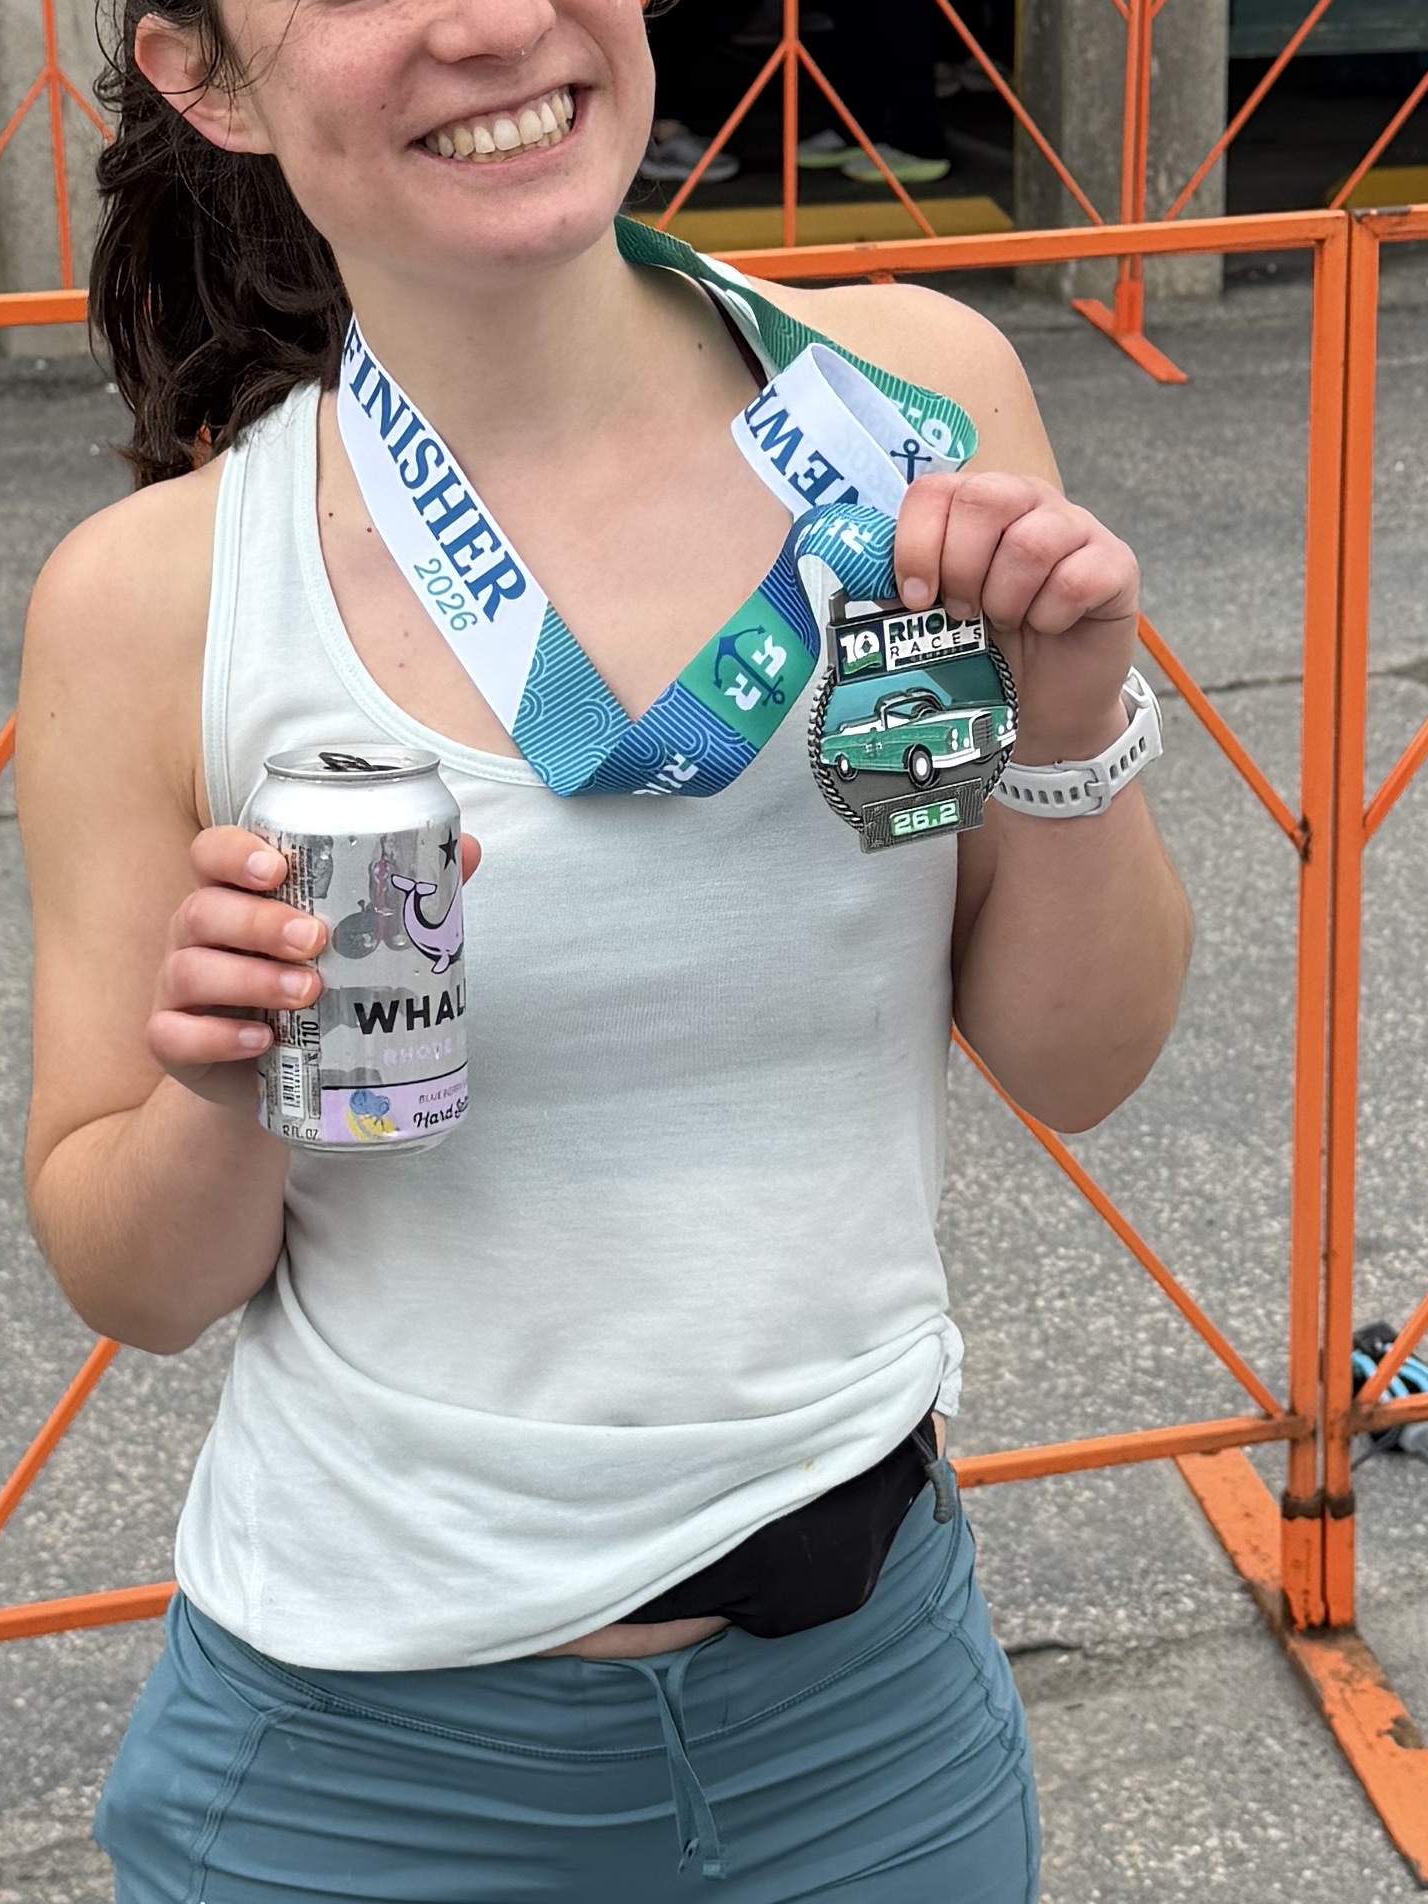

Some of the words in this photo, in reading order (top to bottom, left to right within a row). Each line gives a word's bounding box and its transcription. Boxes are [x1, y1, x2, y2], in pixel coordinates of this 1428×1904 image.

[343, 319, 528, 623] FINISHER
[413, 557, 478, 632] 2026
[890, 627, 983, 659] RACES
[892, 802, 959, 836] 26.2
